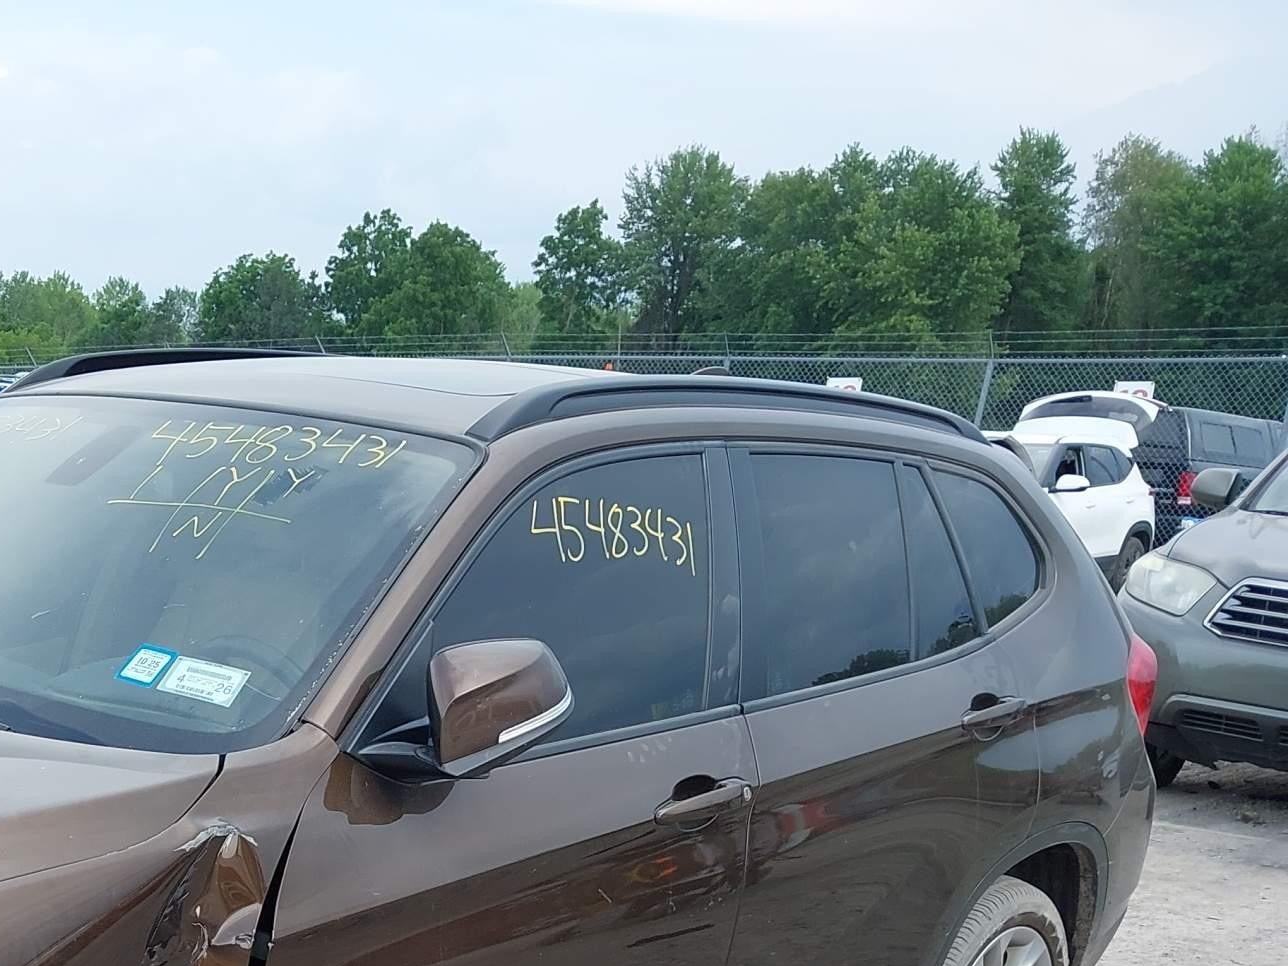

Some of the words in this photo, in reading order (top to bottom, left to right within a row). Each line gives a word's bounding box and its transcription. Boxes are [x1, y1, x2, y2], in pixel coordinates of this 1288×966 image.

[151, 420, 408, 468] 45483431
[531, 496, 697, 577] 45483431
[214, 682, 233, 695] 26
